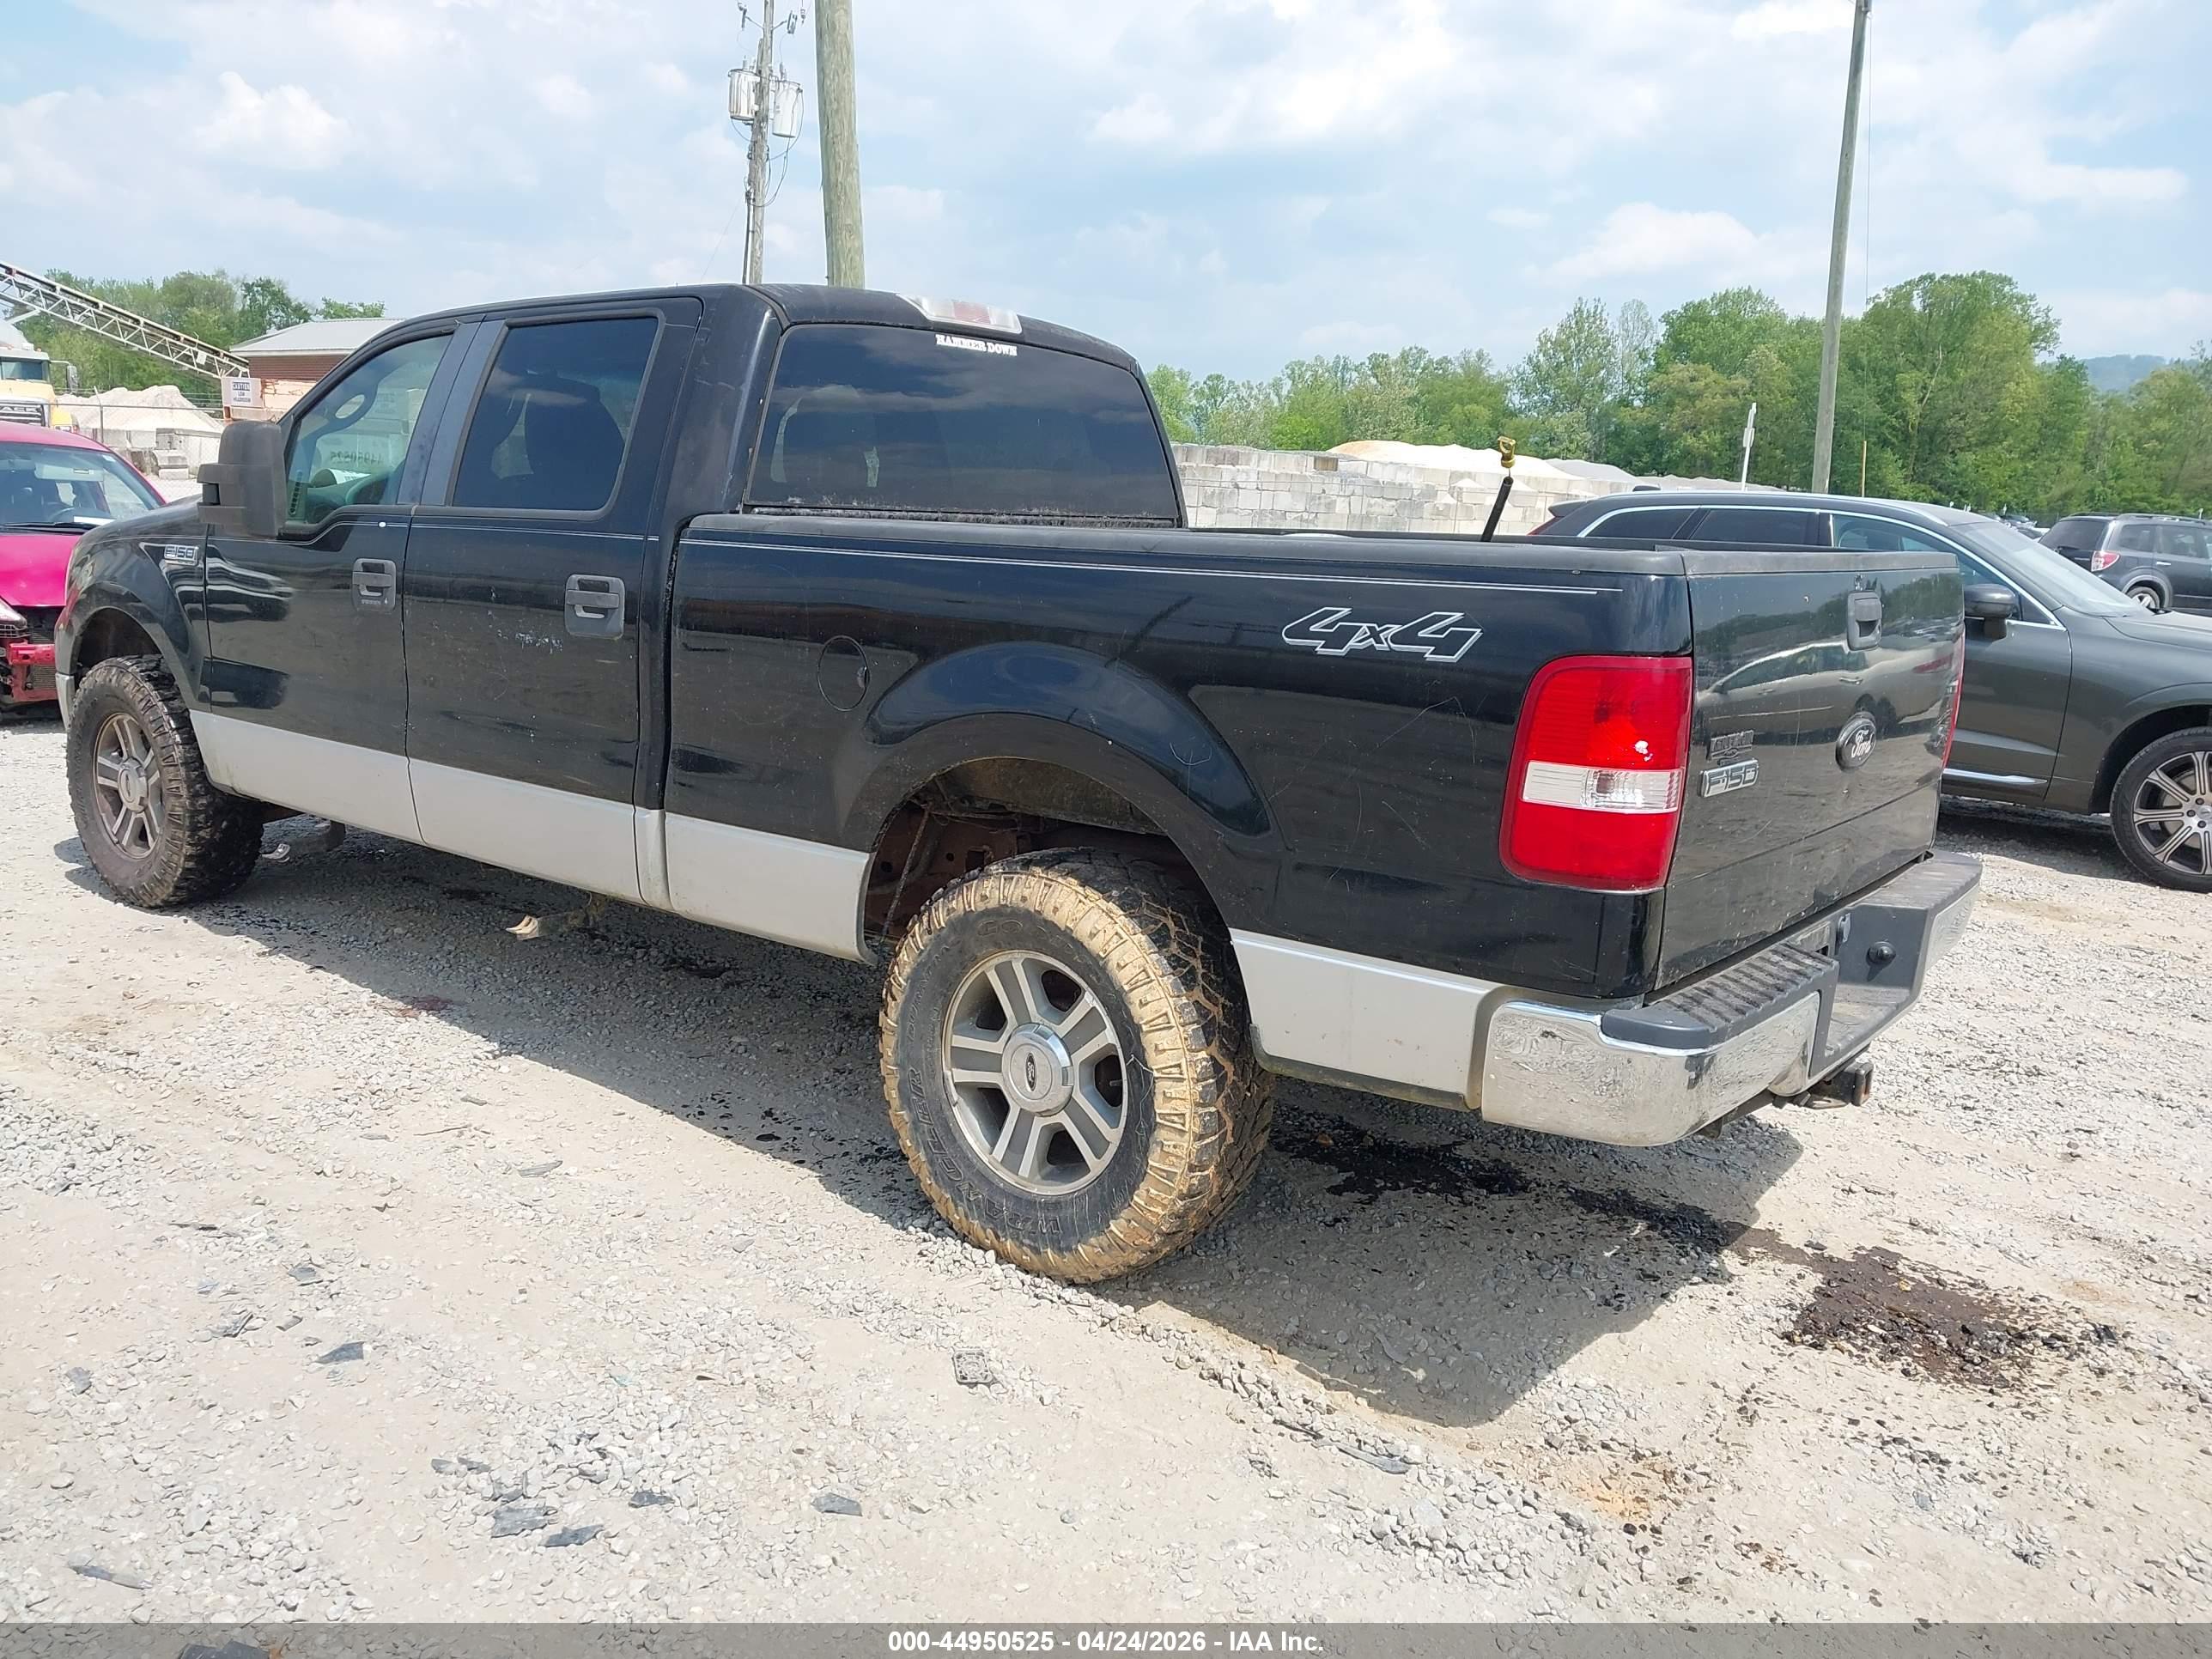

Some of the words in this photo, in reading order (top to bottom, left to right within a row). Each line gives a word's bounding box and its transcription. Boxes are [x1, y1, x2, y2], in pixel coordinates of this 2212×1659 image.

[935, 334, 987, 352] HAMMER
[987, 342, 1018, 356] DOWN
[1282, 607, 1484, 663] 4x4
[1851, 730, 1872, 757] Ford
